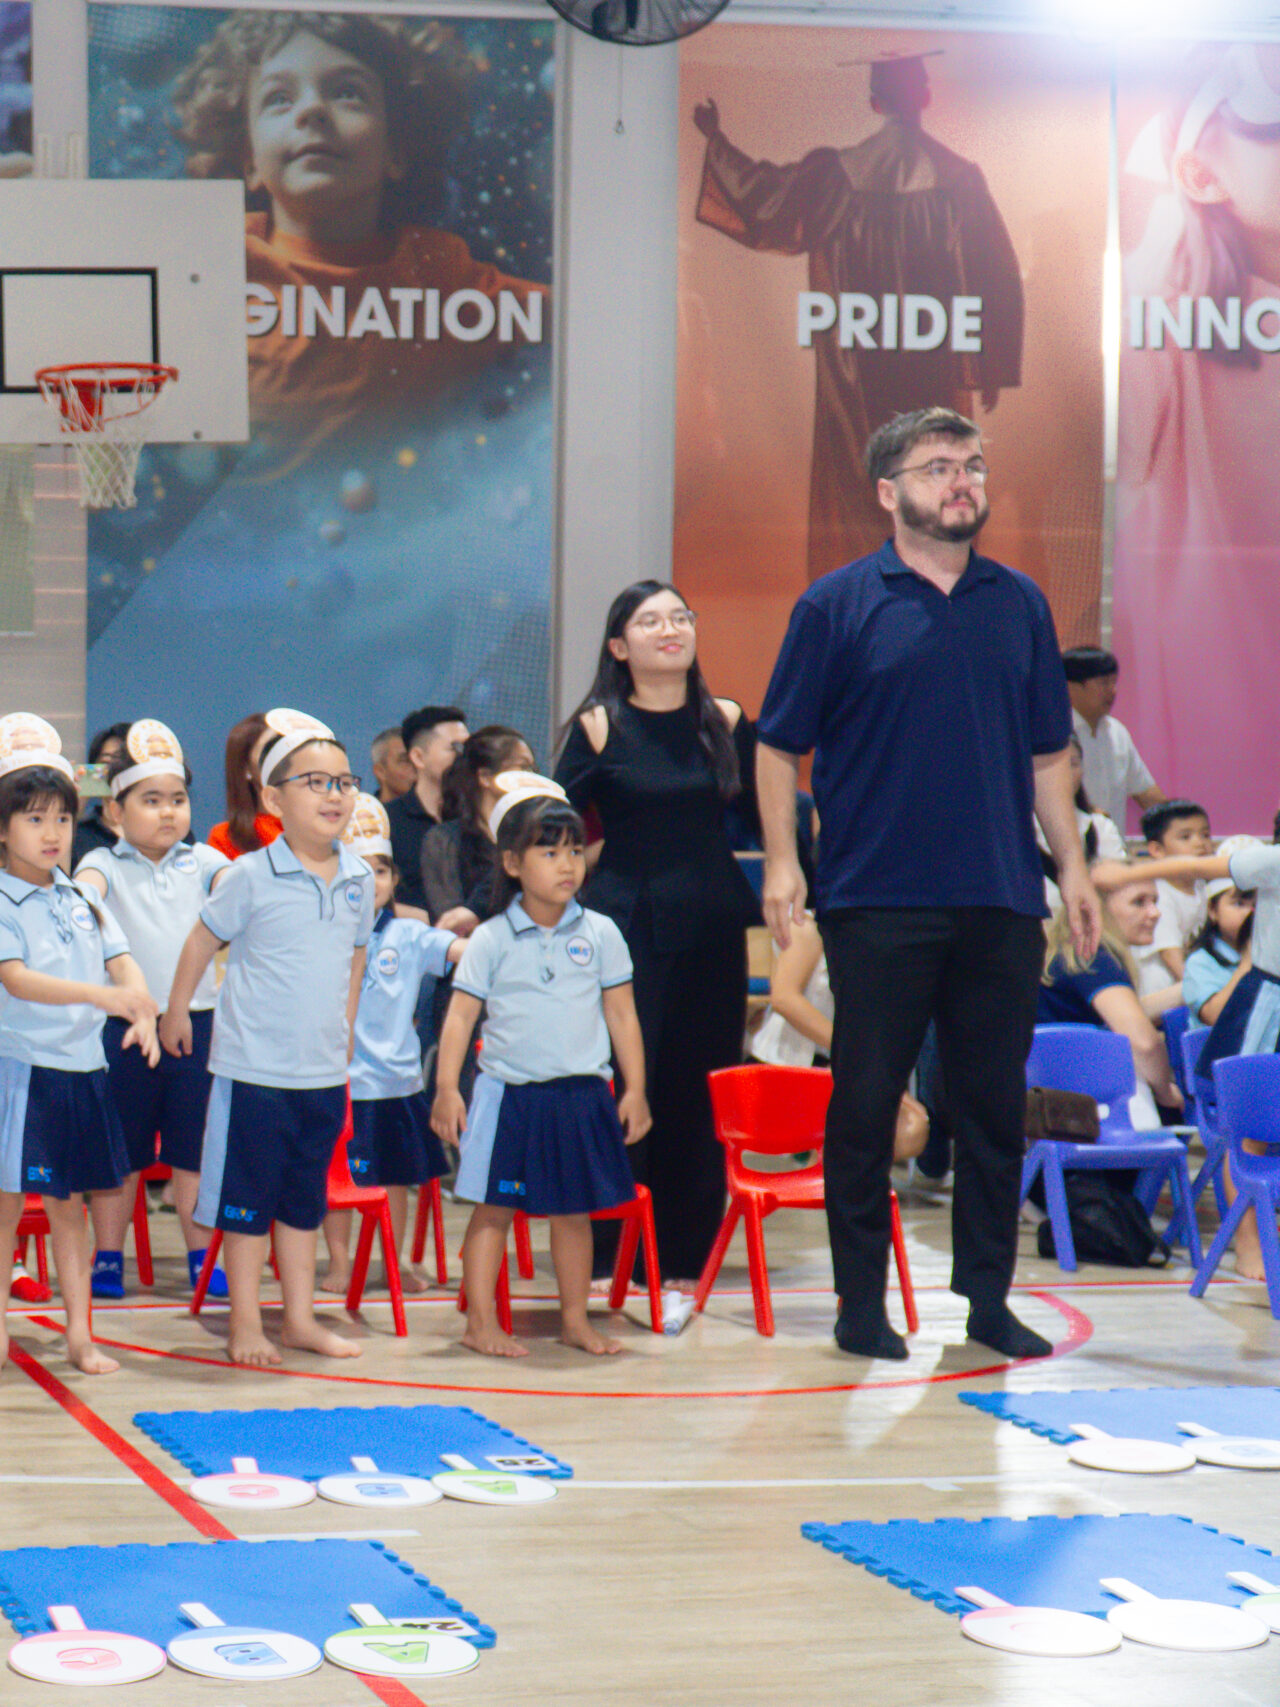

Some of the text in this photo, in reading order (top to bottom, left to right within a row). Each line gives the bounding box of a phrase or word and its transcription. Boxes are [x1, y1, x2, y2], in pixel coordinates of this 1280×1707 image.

[246, 282, 543, 343] GINATION
[798, 291, 982, 353] PRIDE
[1130, 295, 1280, 352] INNO
